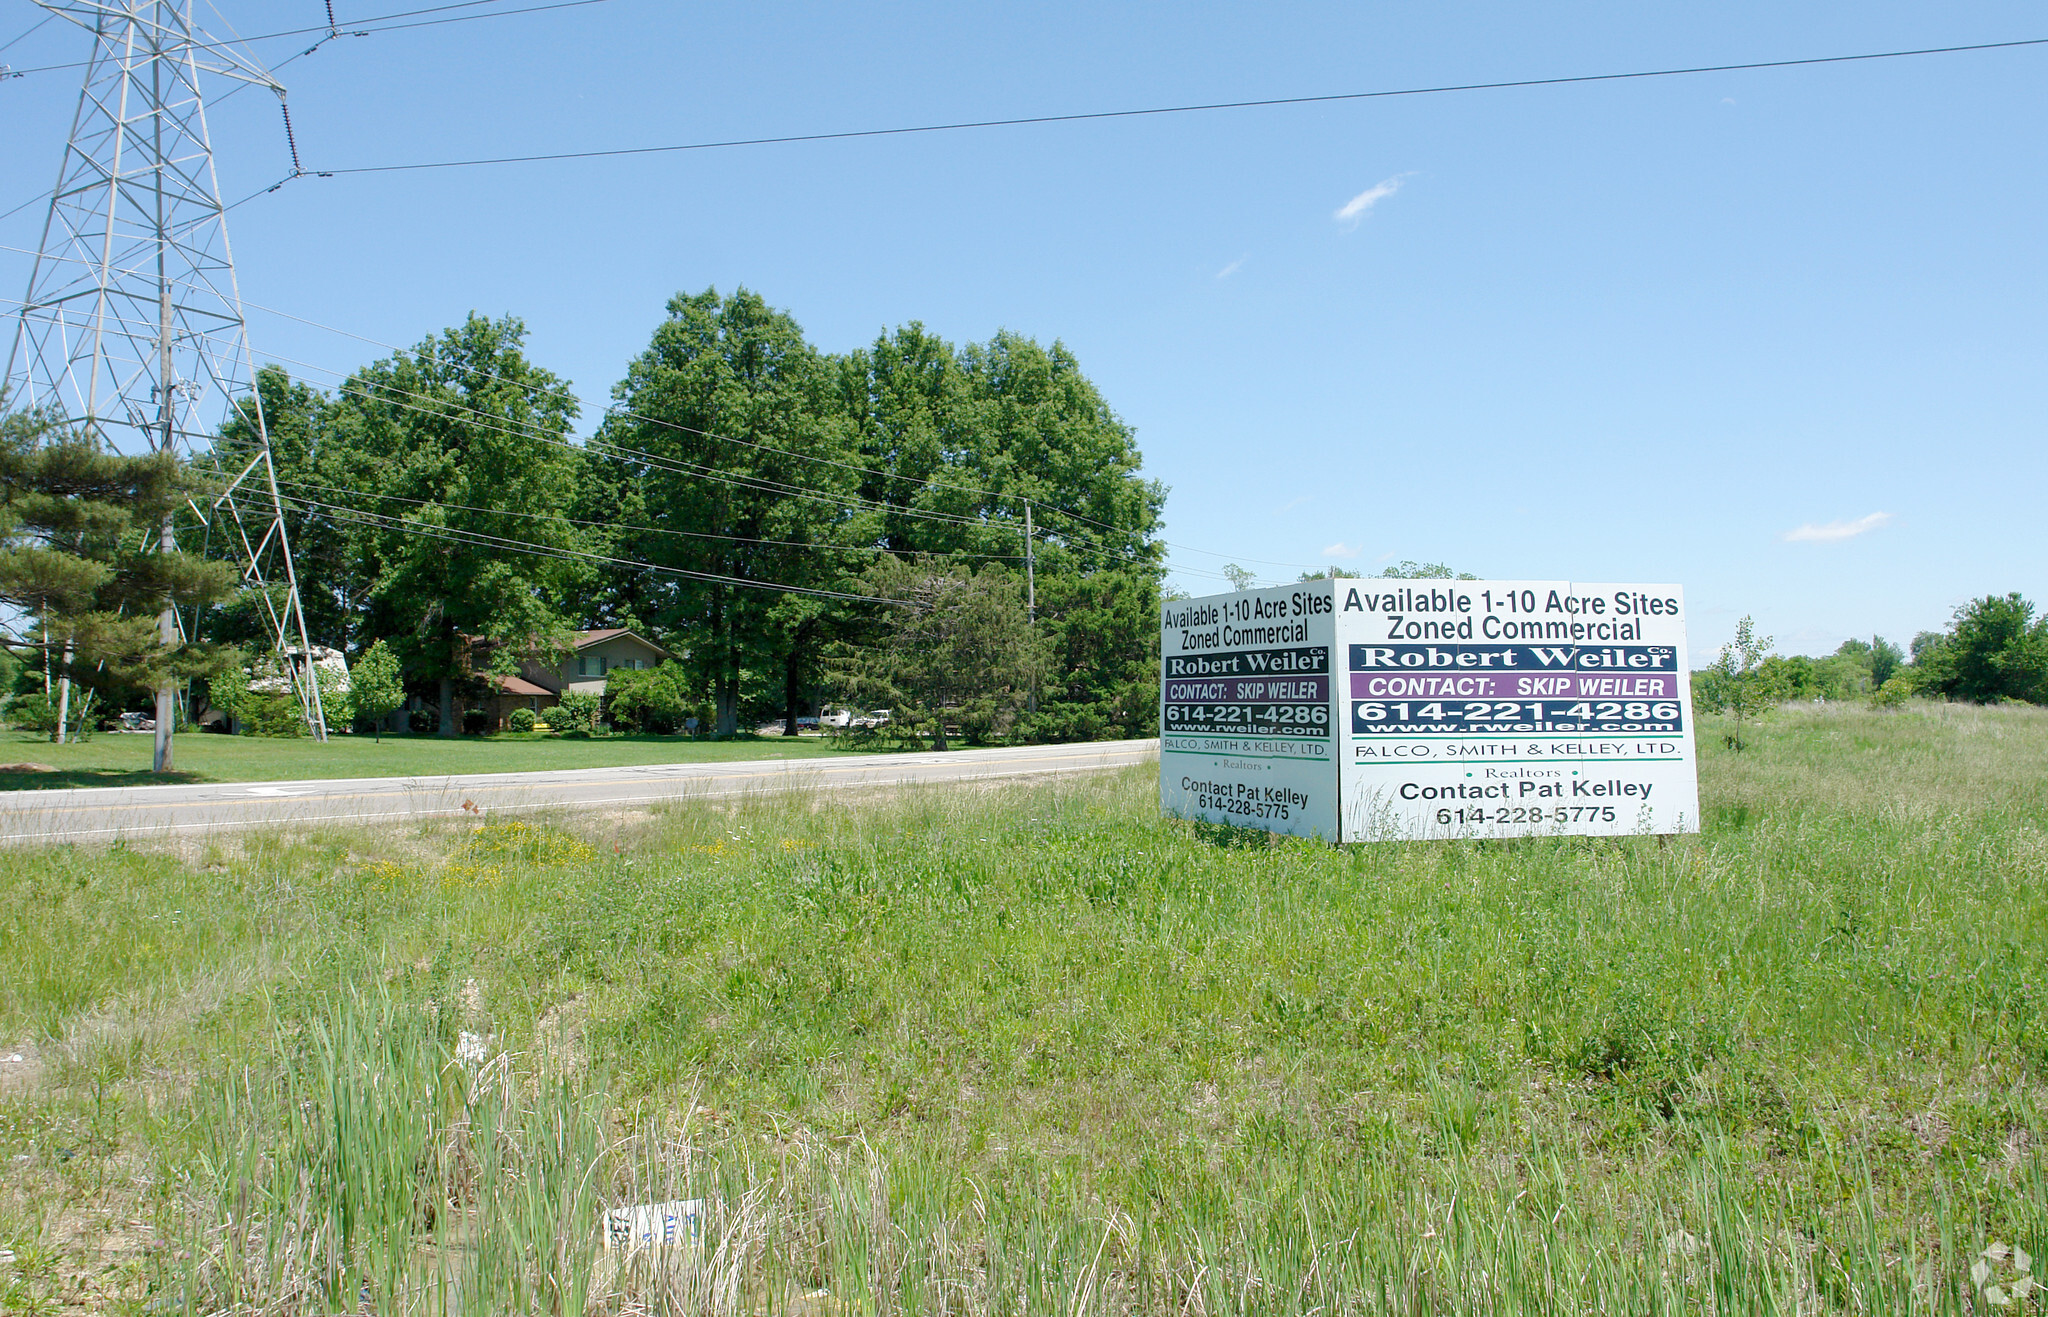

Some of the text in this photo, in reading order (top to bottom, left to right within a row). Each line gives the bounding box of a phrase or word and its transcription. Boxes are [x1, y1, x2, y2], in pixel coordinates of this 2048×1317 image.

[1165, 592, 1333, 630] Available 1-10 Acre Sites
[1343, 587, 1679, 616] Available 1-10 Acre Sites
[1182, 618, 1308, 650] Zoned Commercial
[1387, 615, 1641, 640] Zoned Commercial
[1170, 656, 1240, 675] Robert
[1245, 651, 1324, 672] Weiler
[1360, 646, 1673, 668] Robert Weiler Co.
[1170, 681, 1318, 700] CONTACT: SKIP WEILER
[1368, 677, 1665, 696] CONTACT: SKIP WEILER
[1166, 705, 1328, 724] 614-221-4286
[1357, 702, 1679, 721] 614-221-4286
[1170, 723, 1324, 736] www.rweiler.com
[1366, 721, 1674, 732] www.rweiler.com
[1165, 739, 1328, 756] FALCO, SMITH & KELLEY, LTD.
[1356, 743, 1681, 758] FALCO, SMITH & KELLEY, LTD.
[1223, 759, 1262, 771] Realtors
[1484, 767, 1561, 778] Realtors
[1181, 776, 1308, 810] Contact Pat Kelley
[1399, 779, 1653, 800] Contact Pat Kelley
[1199, 794, 1289, 820] 614-228-5775
[1436, 806, 1616, 824] 614-228-5775
